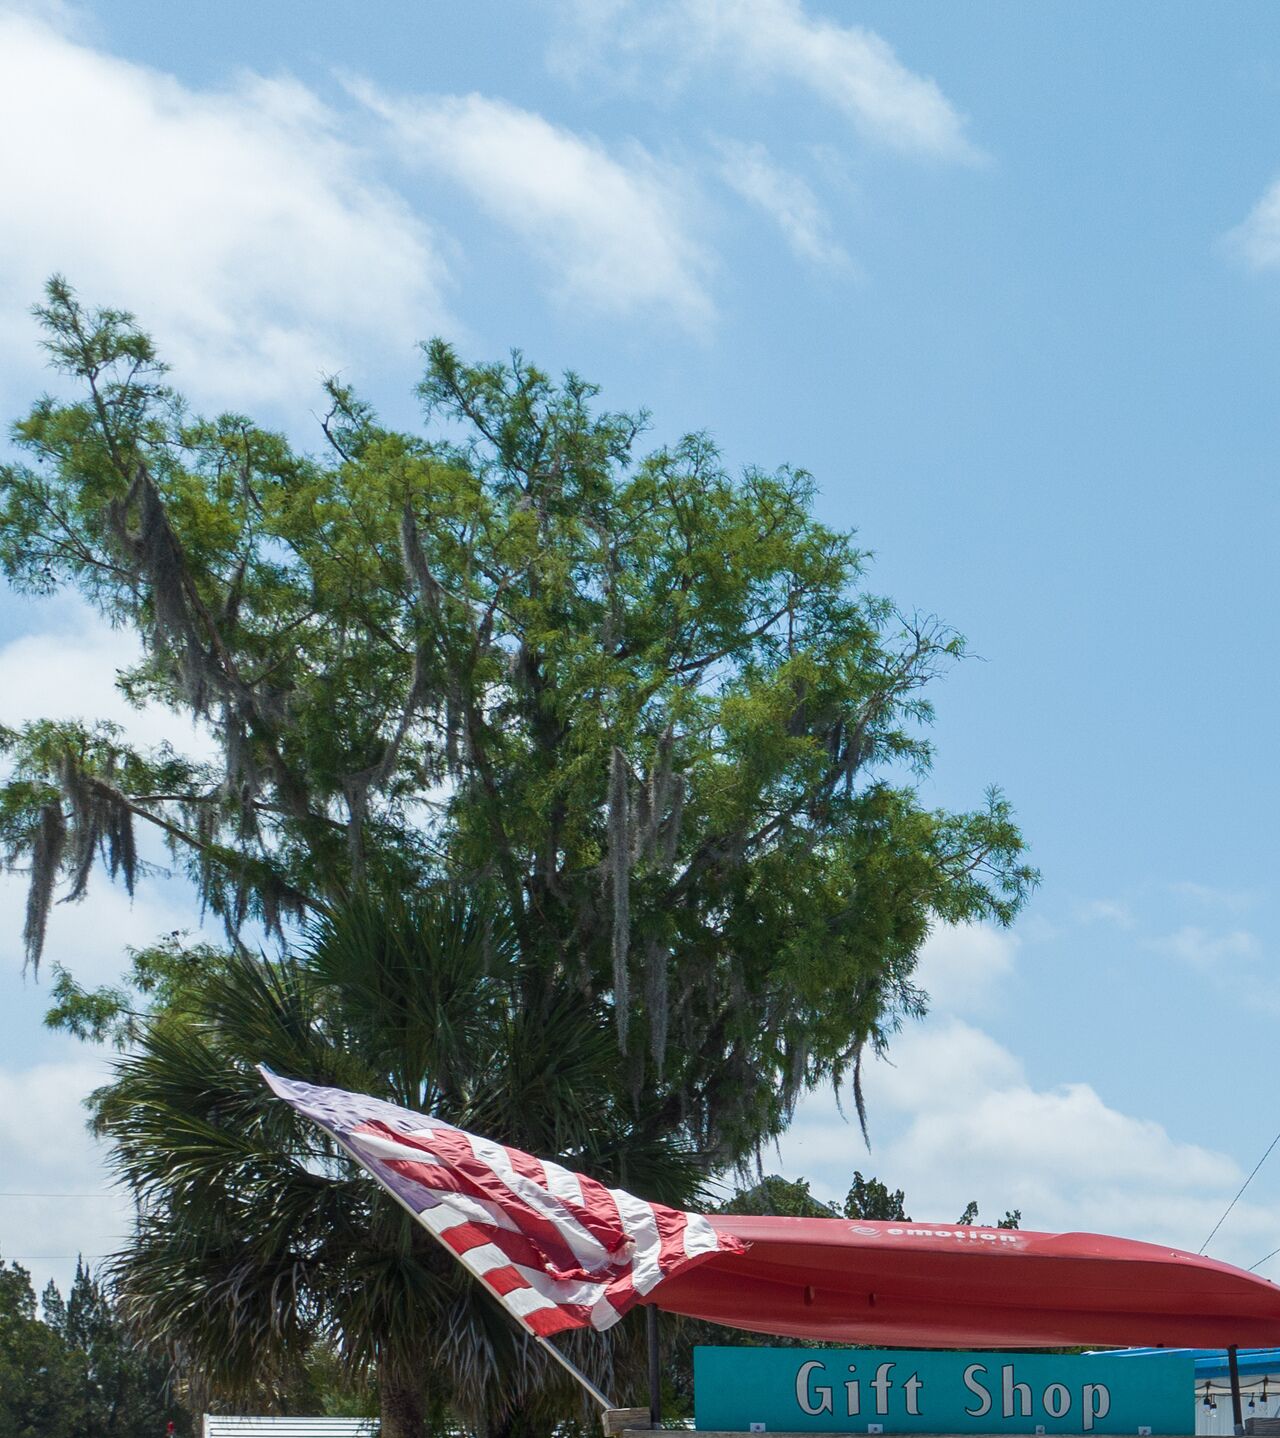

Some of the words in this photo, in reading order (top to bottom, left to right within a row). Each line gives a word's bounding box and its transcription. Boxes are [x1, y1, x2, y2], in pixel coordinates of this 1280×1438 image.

[887, 1228, 1017, 1243] emotion
[795, 1360, 923, 1417] Gift
[963, 1363, 1111, 1431] Shop
